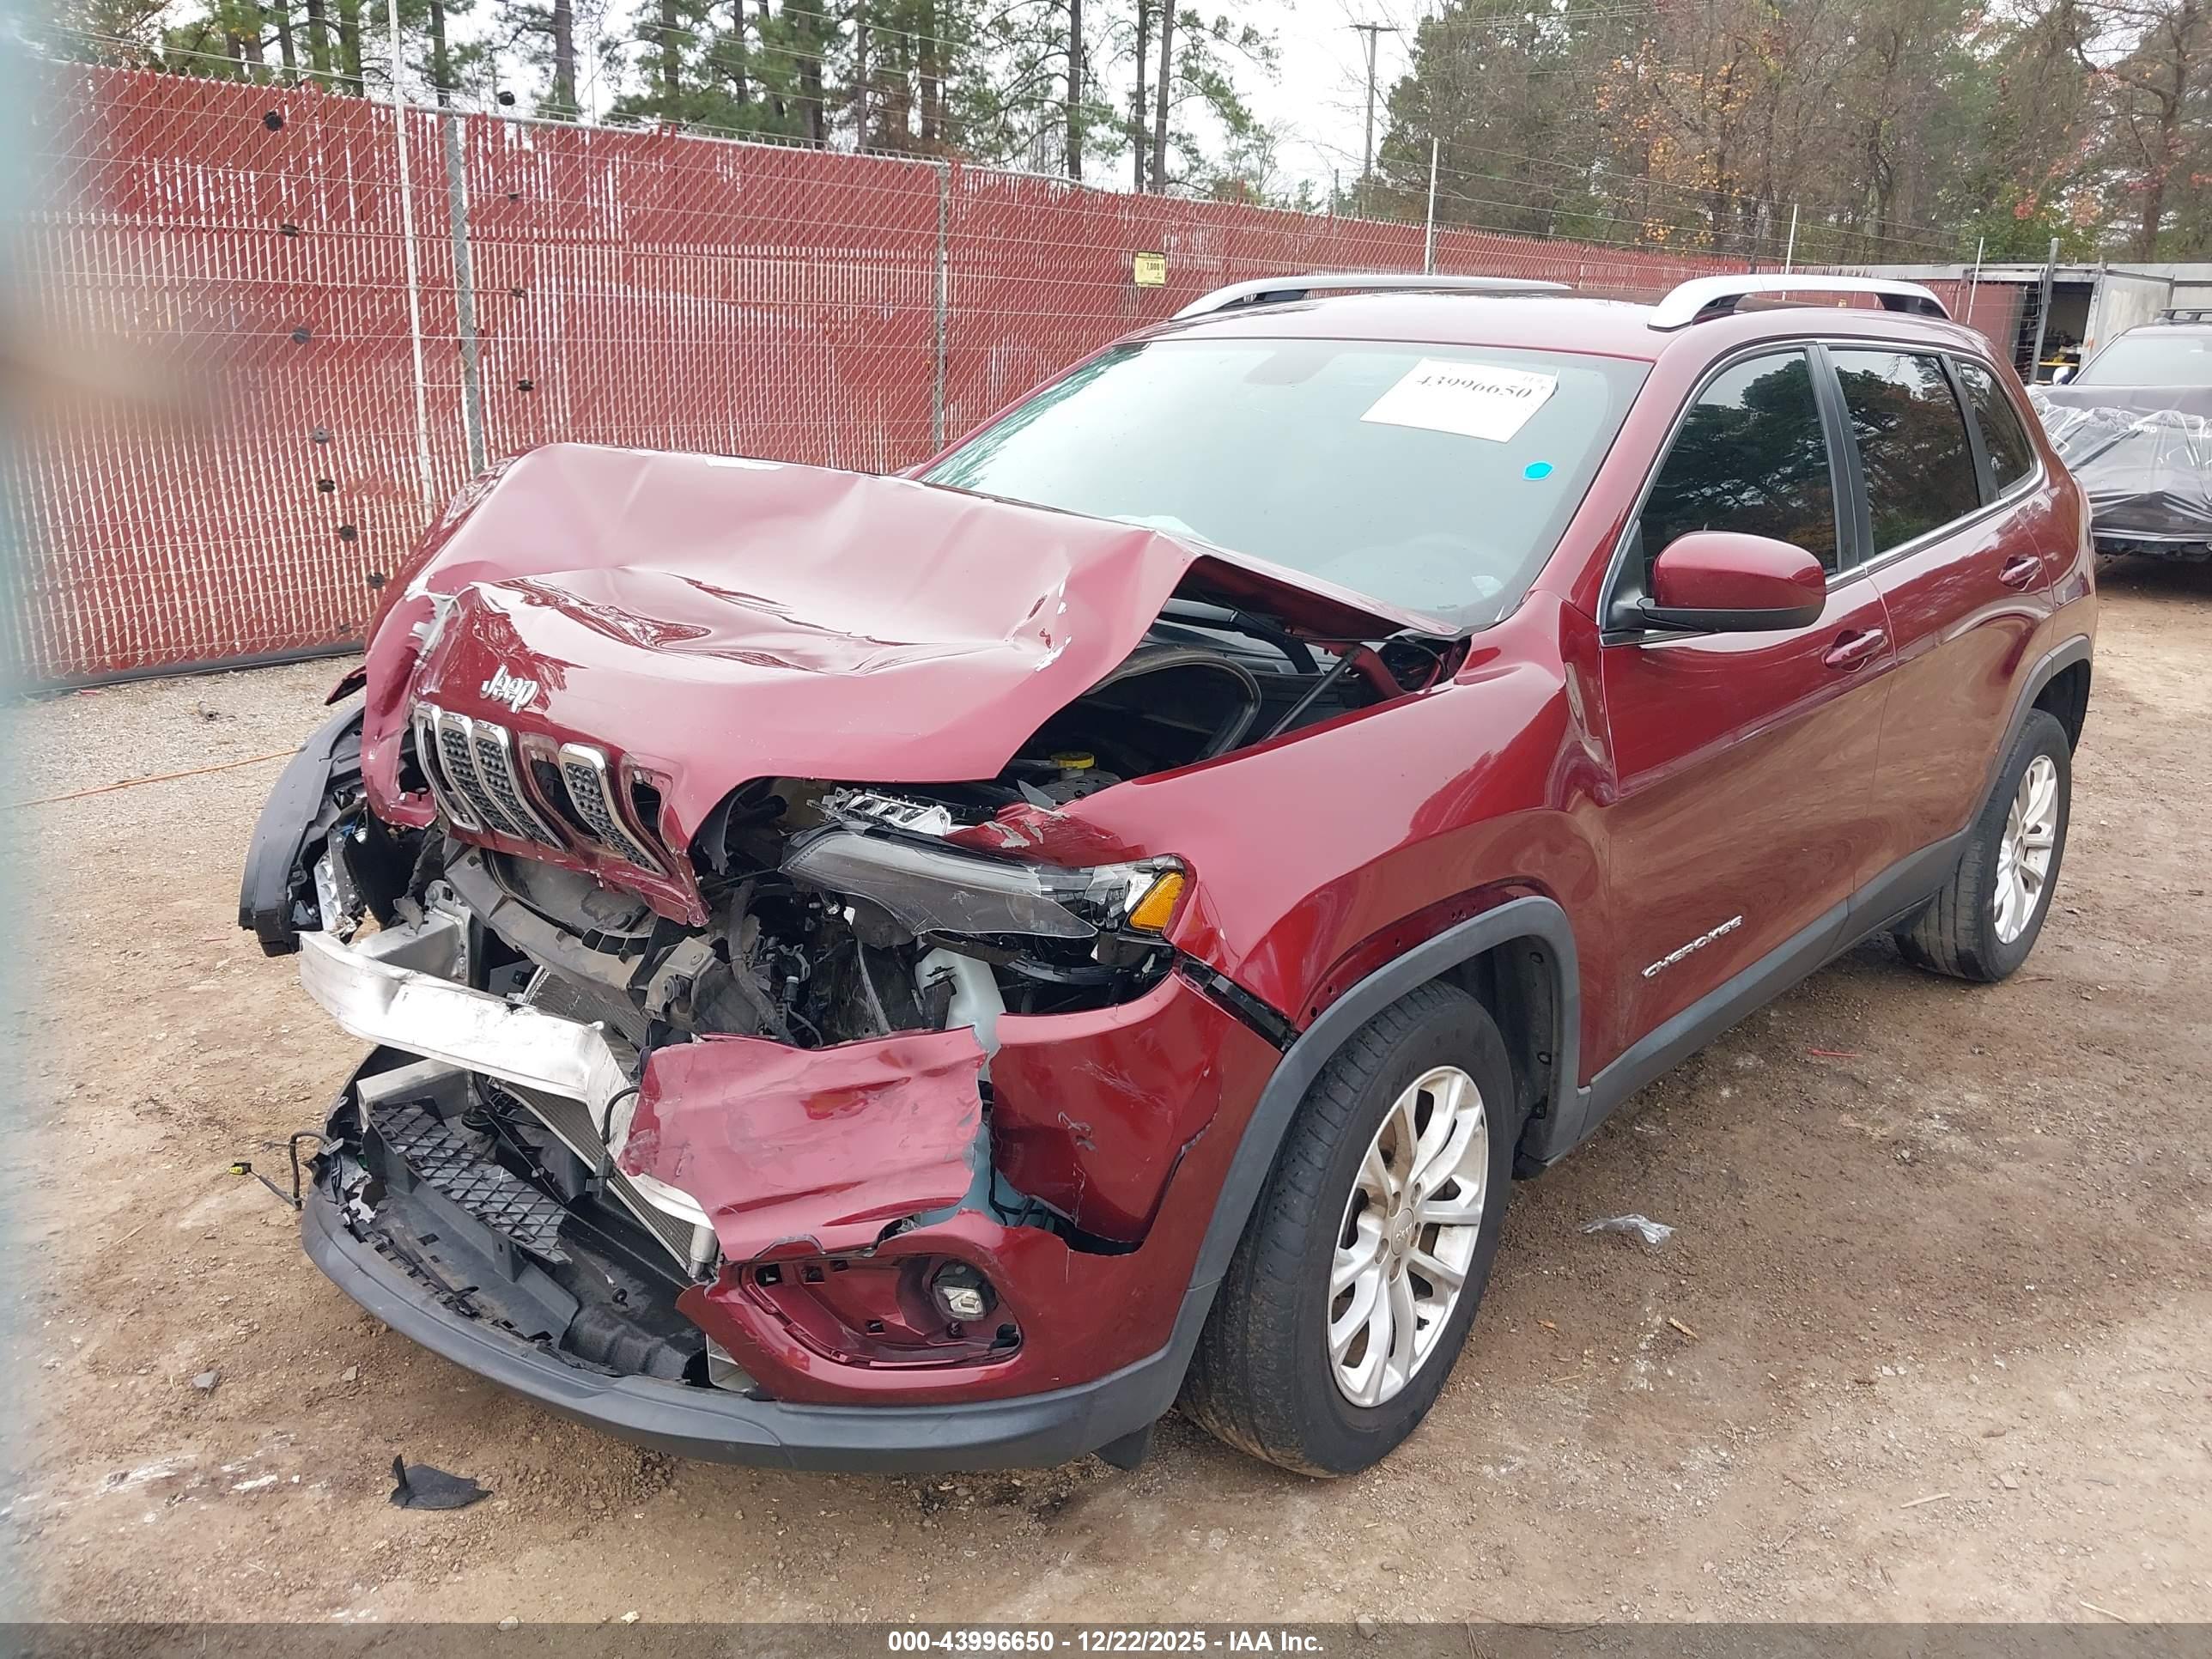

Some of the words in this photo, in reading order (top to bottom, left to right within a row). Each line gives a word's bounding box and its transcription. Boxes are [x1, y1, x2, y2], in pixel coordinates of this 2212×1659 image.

[1416, 375, 1533, 398] 43996650
[480, 662, 539, 714] Jeep
[1641, 915, 1743, 978] CHEROKEE
